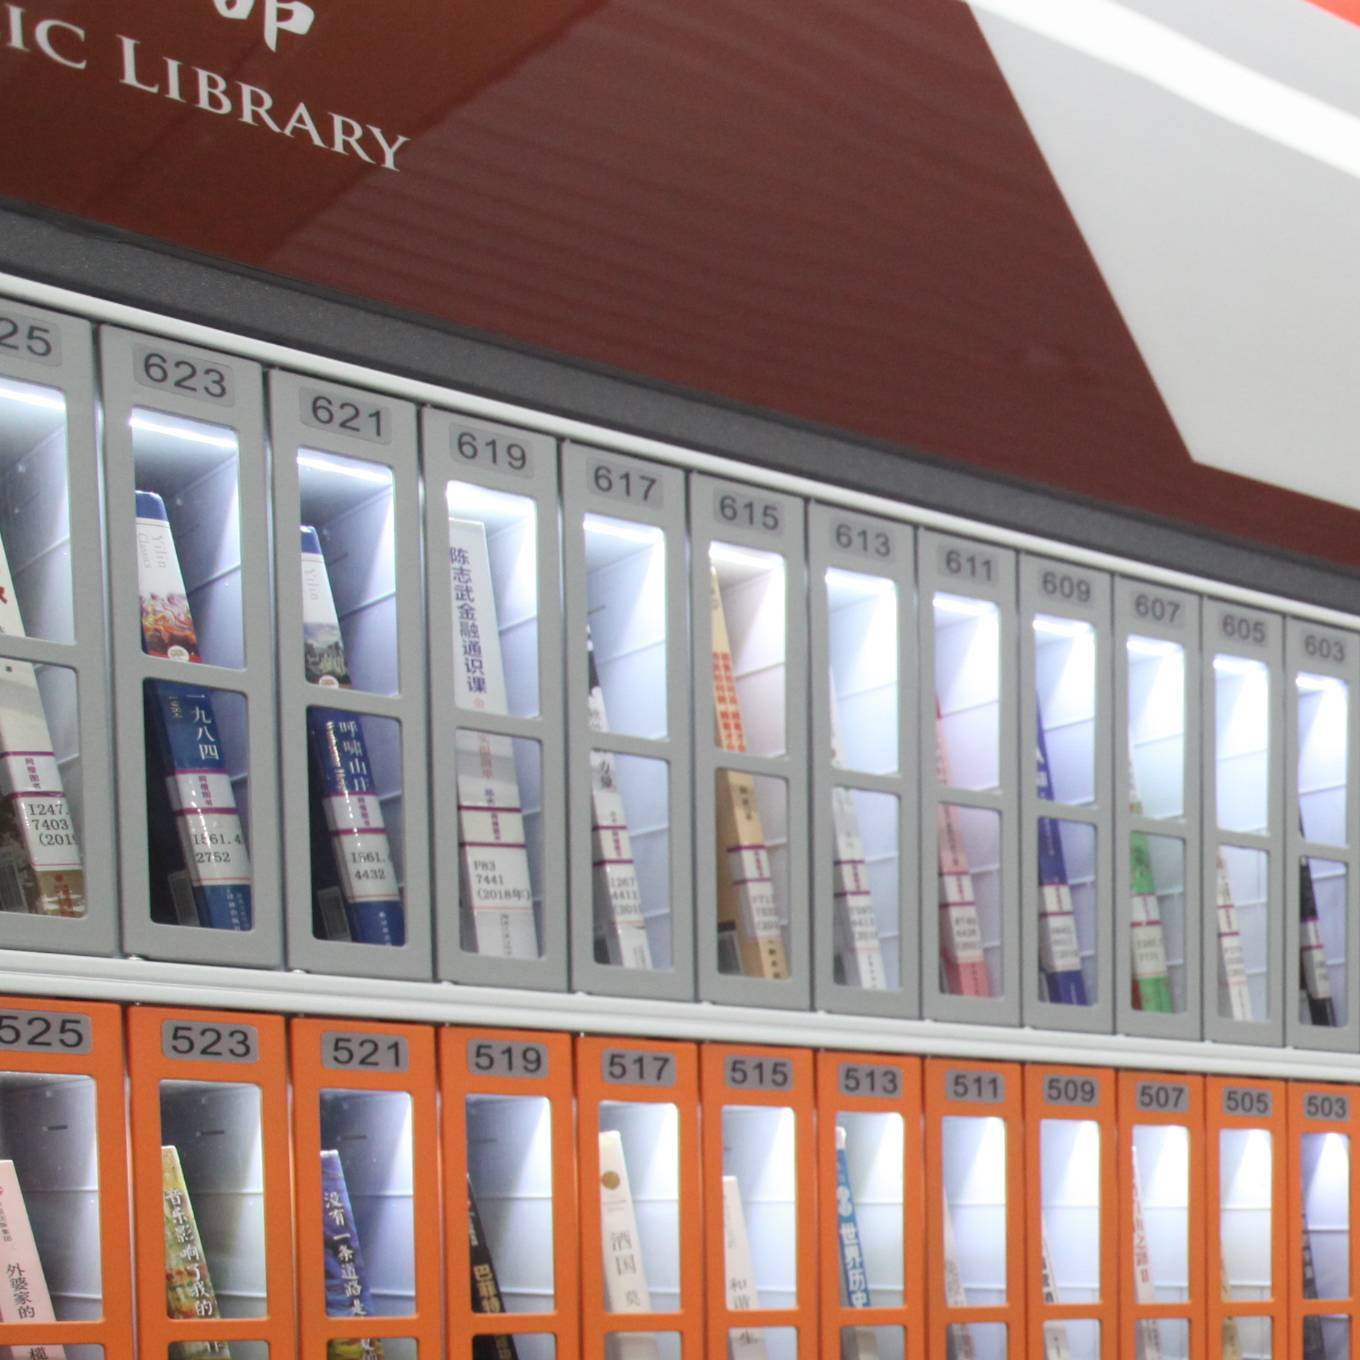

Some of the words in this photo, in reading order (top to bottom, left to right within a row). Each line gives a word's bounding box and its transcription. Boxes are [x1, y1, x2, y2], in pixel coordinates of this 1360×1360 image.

[119, 36, 411, 172] LIBRARY
[143, 352, 227, 398] 623
[311, 394, 382, 437] 621
[457, 431, 527, 471] 619
[594, 465, 657, 501] 617
[719, 496, 780, 530] 615
[835, 523, 890, 557] 613
[946, 550, 993, 582] 611
[1042, 572, 1091, 602] 609
[449, 546, 488, 694] 陈志武金融通识课
[1135, 594, 1180, 624] 607
[1222, 615, 1266, 643] 605
[1304, 634, 1345, 663] 603
[186, 693, 220, 761] 一九八四
[33, 818, 70, 831] 7403
[193, 850, 232, 865] 2752
[353, 868, 387, 881] 4432
[0, 1016, 84, 1048] 525
[170, 1025, 252, 1058] 523
[332, 1037, 402, 1068] 521
[474, 1044, 542, 1073] 519
[608, 1053, 671, 1081] 517
[730, 1060, 789, 1087] 515
[844, 1067, 898, 1094] 513
[953, 1074, 999, 1099] 511
[1047, 1078, 1096, 1103] 509
[1139, 1085, 1185, 1108] 507
[1226, 1091, 1269, 1114] 505
[1305, 1096, 1347, 1119] 503
[6, 1263, 36, 1320] 外婆家的
